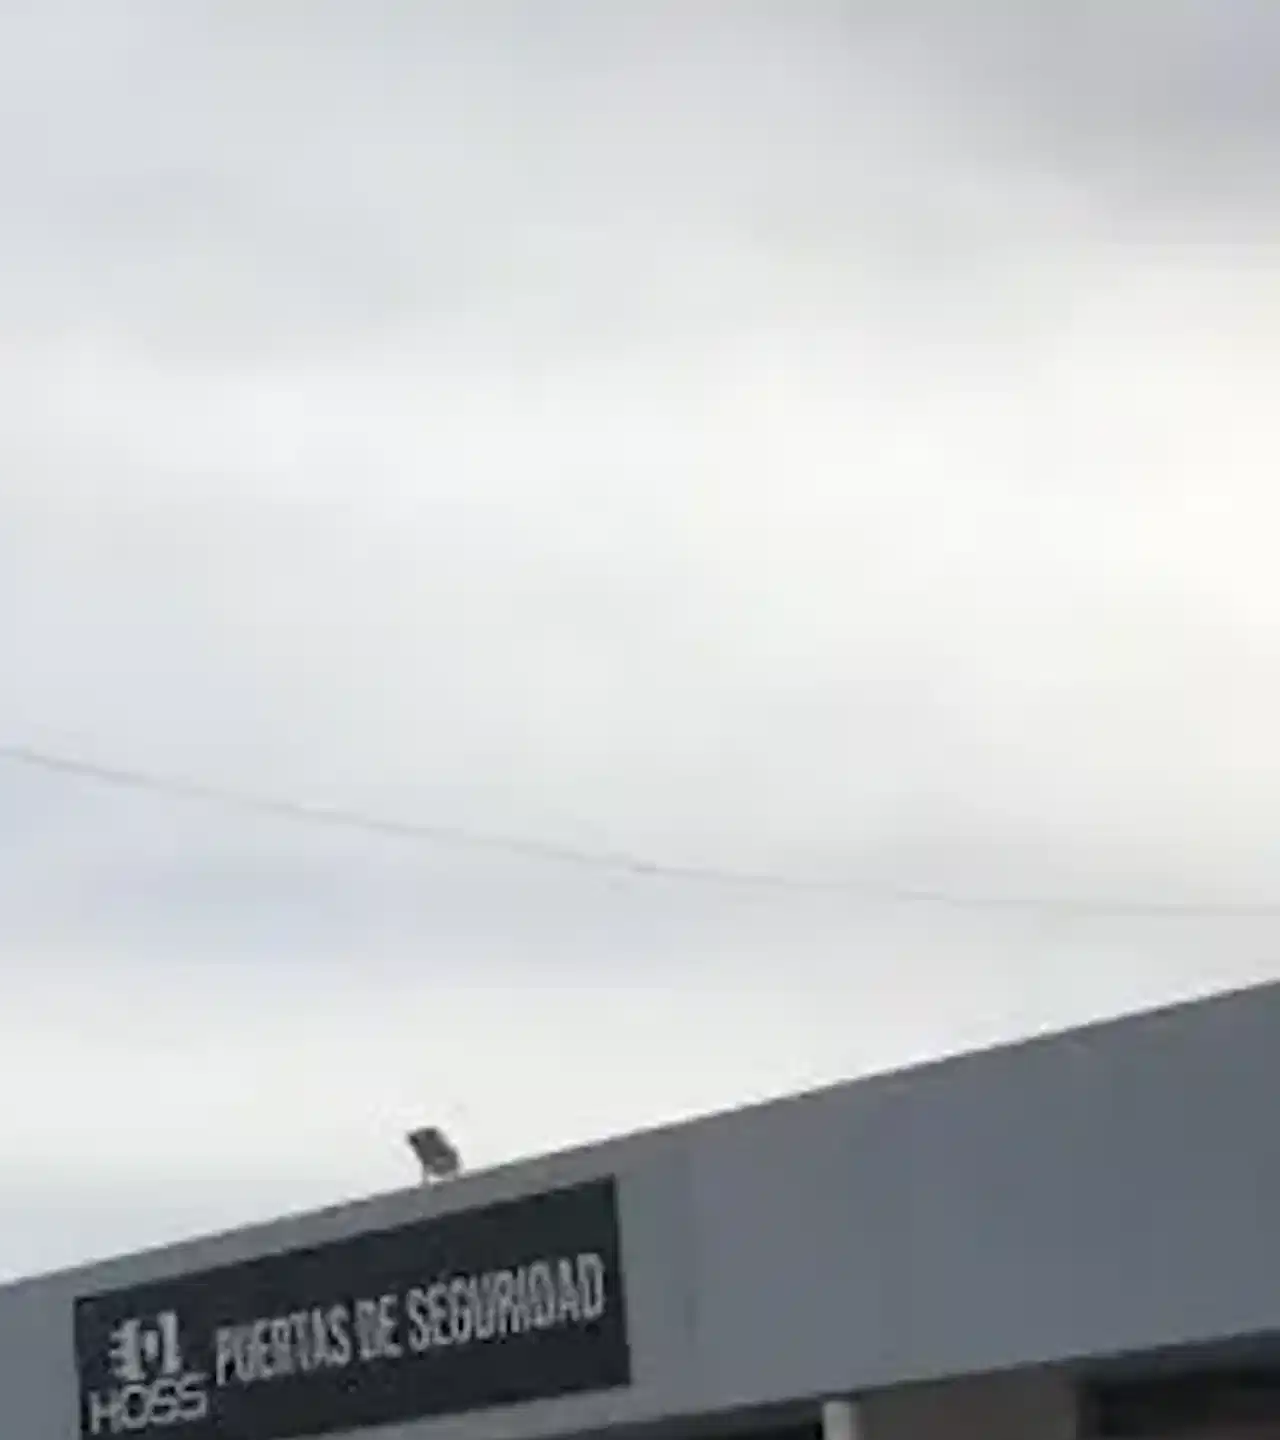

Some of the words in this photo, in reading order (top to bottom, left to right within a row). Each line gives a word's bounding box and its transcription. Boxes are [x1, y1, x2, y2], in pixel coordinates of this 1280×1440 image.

[215, 1304, 351, 1387] PUERTAS
[354, 1295, 404, 1362] DE
[406, 1253, 605, 1352] SEGURIDAD
[89, 1374, 209, 1434] HOSS
